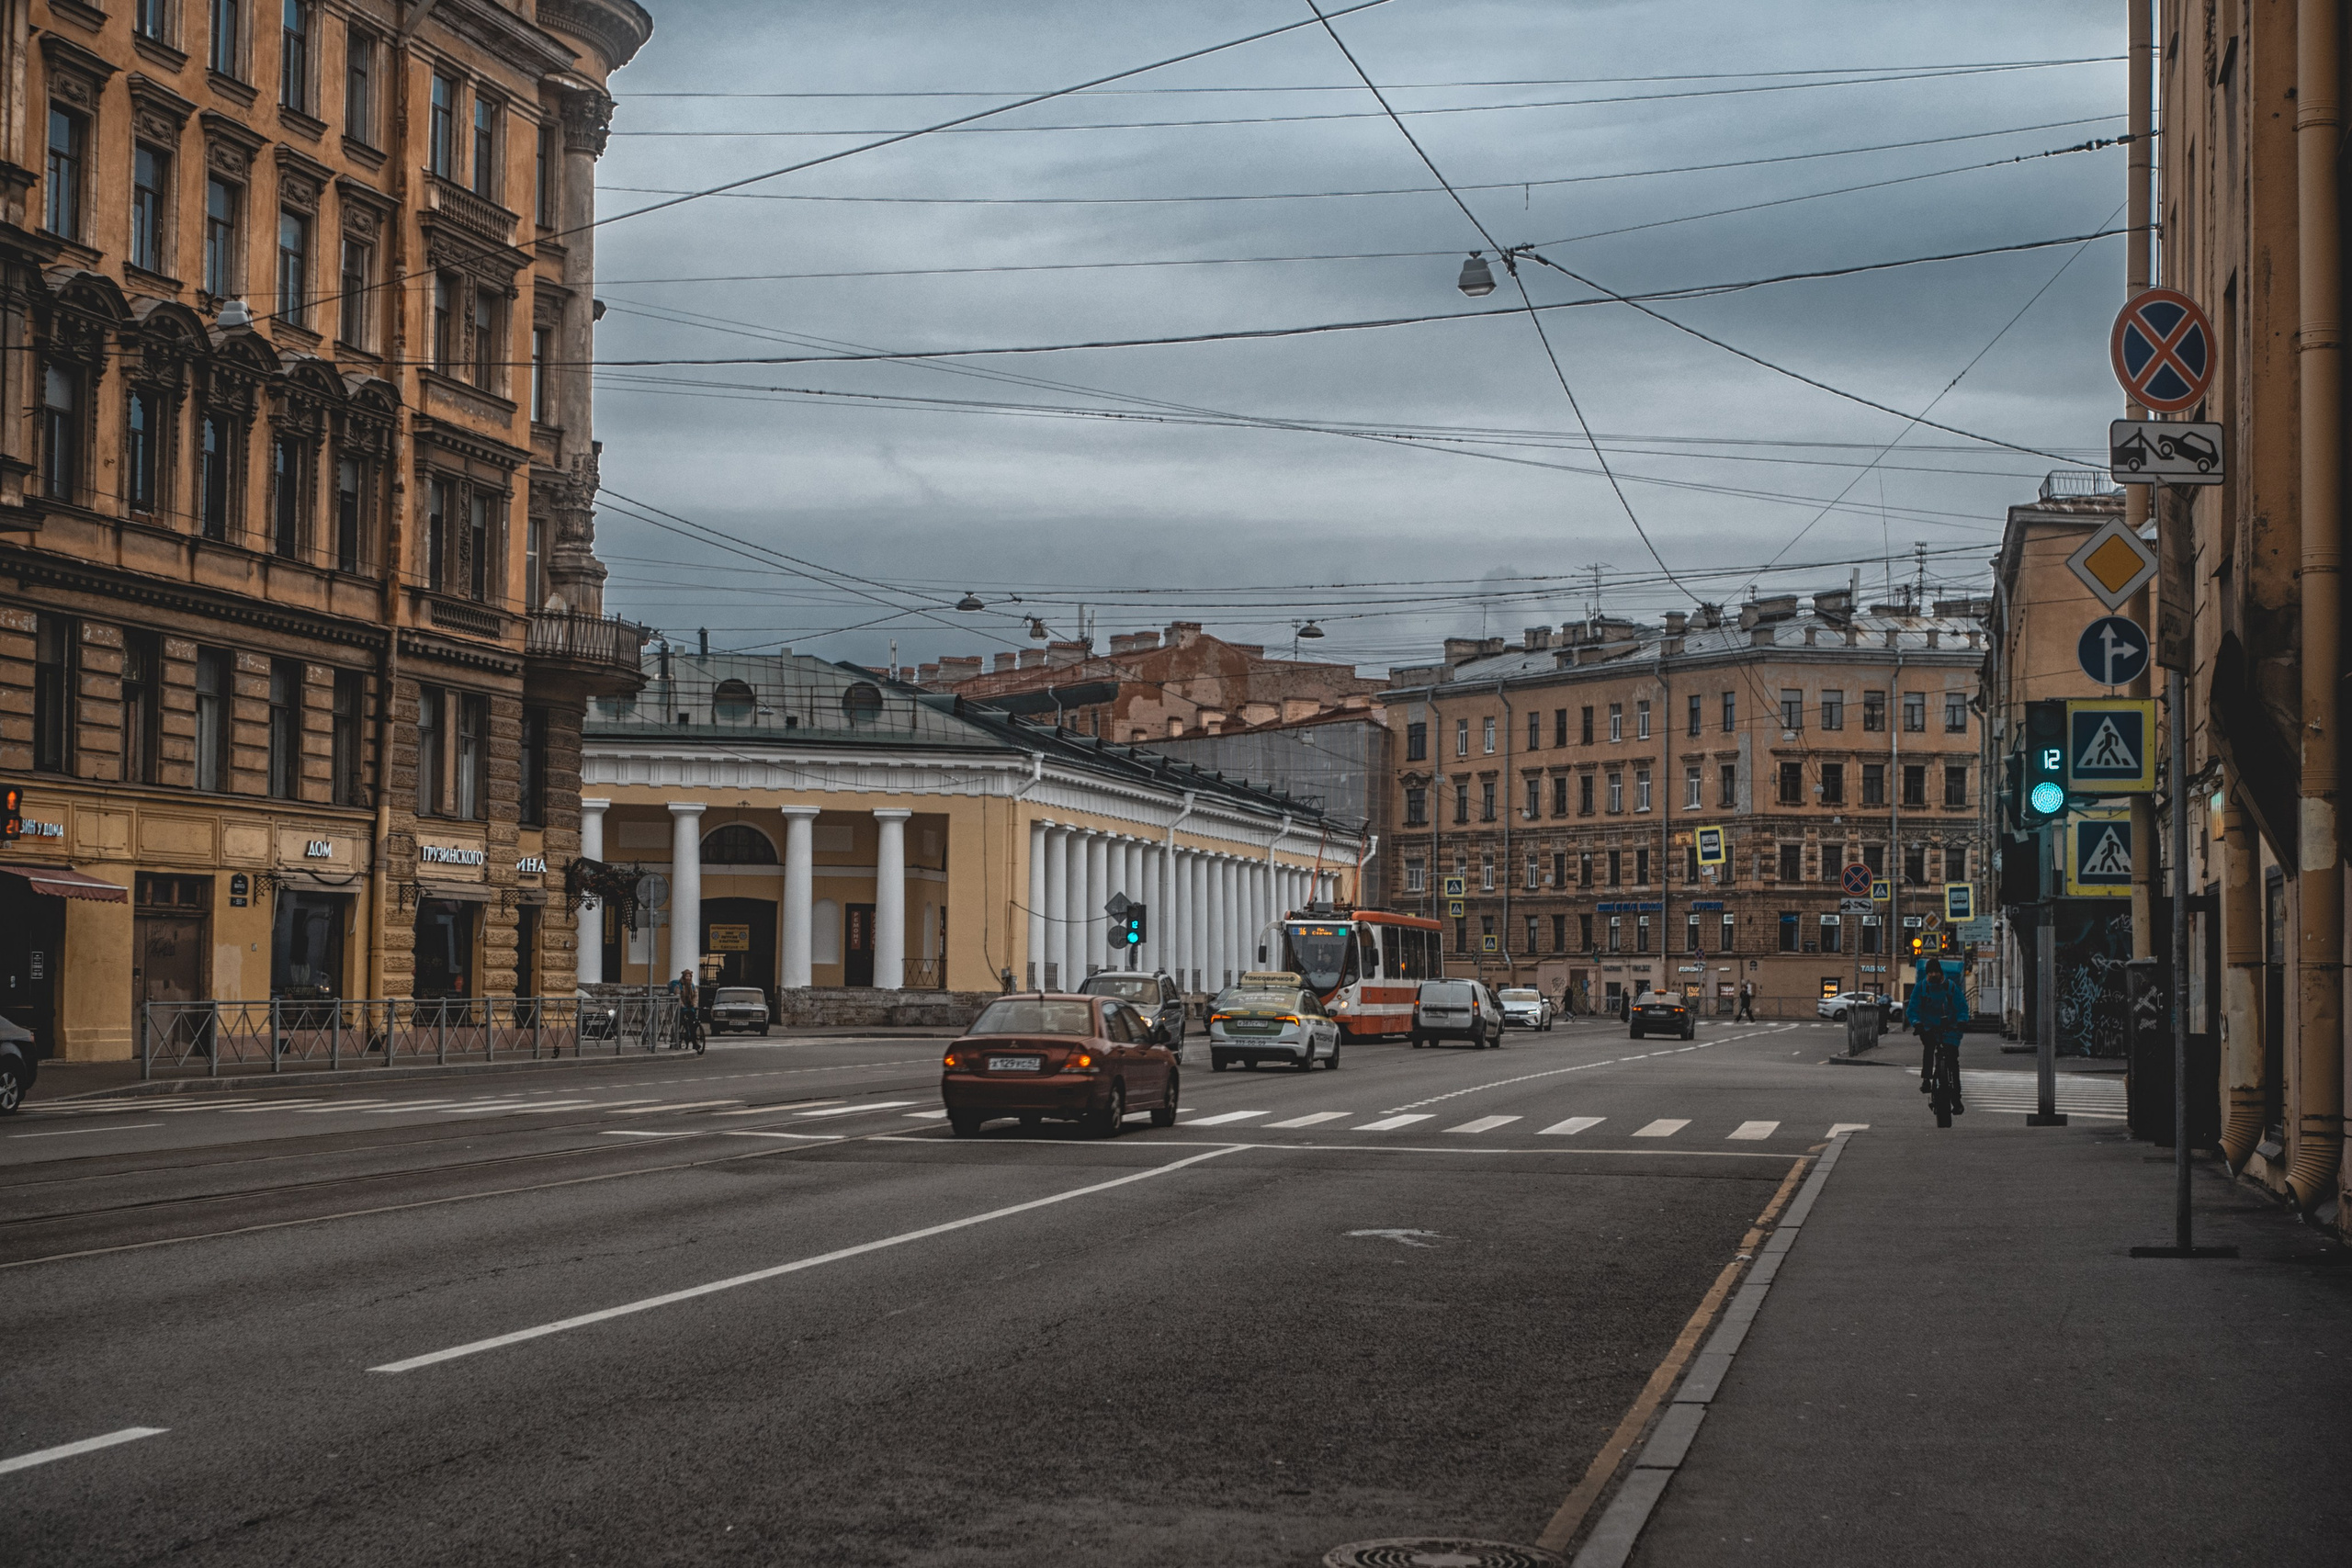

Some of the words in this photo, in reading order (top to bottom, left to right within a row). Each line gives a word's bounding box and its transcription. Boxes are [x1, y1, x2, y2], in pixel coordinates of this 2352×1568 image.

[2043, 749, 2061, 770] 12
[19, 819, 36, 835] ЗИН
[43, 823, 63, 838] ДОМА
[307, 840, 333, 857] ДОМ
[423, 846, 483, 865] ГРУЗИНСКОГО
[515, 858, 548, 873] ИНА
[1860, 964, 1886, 973] ТАБАК
